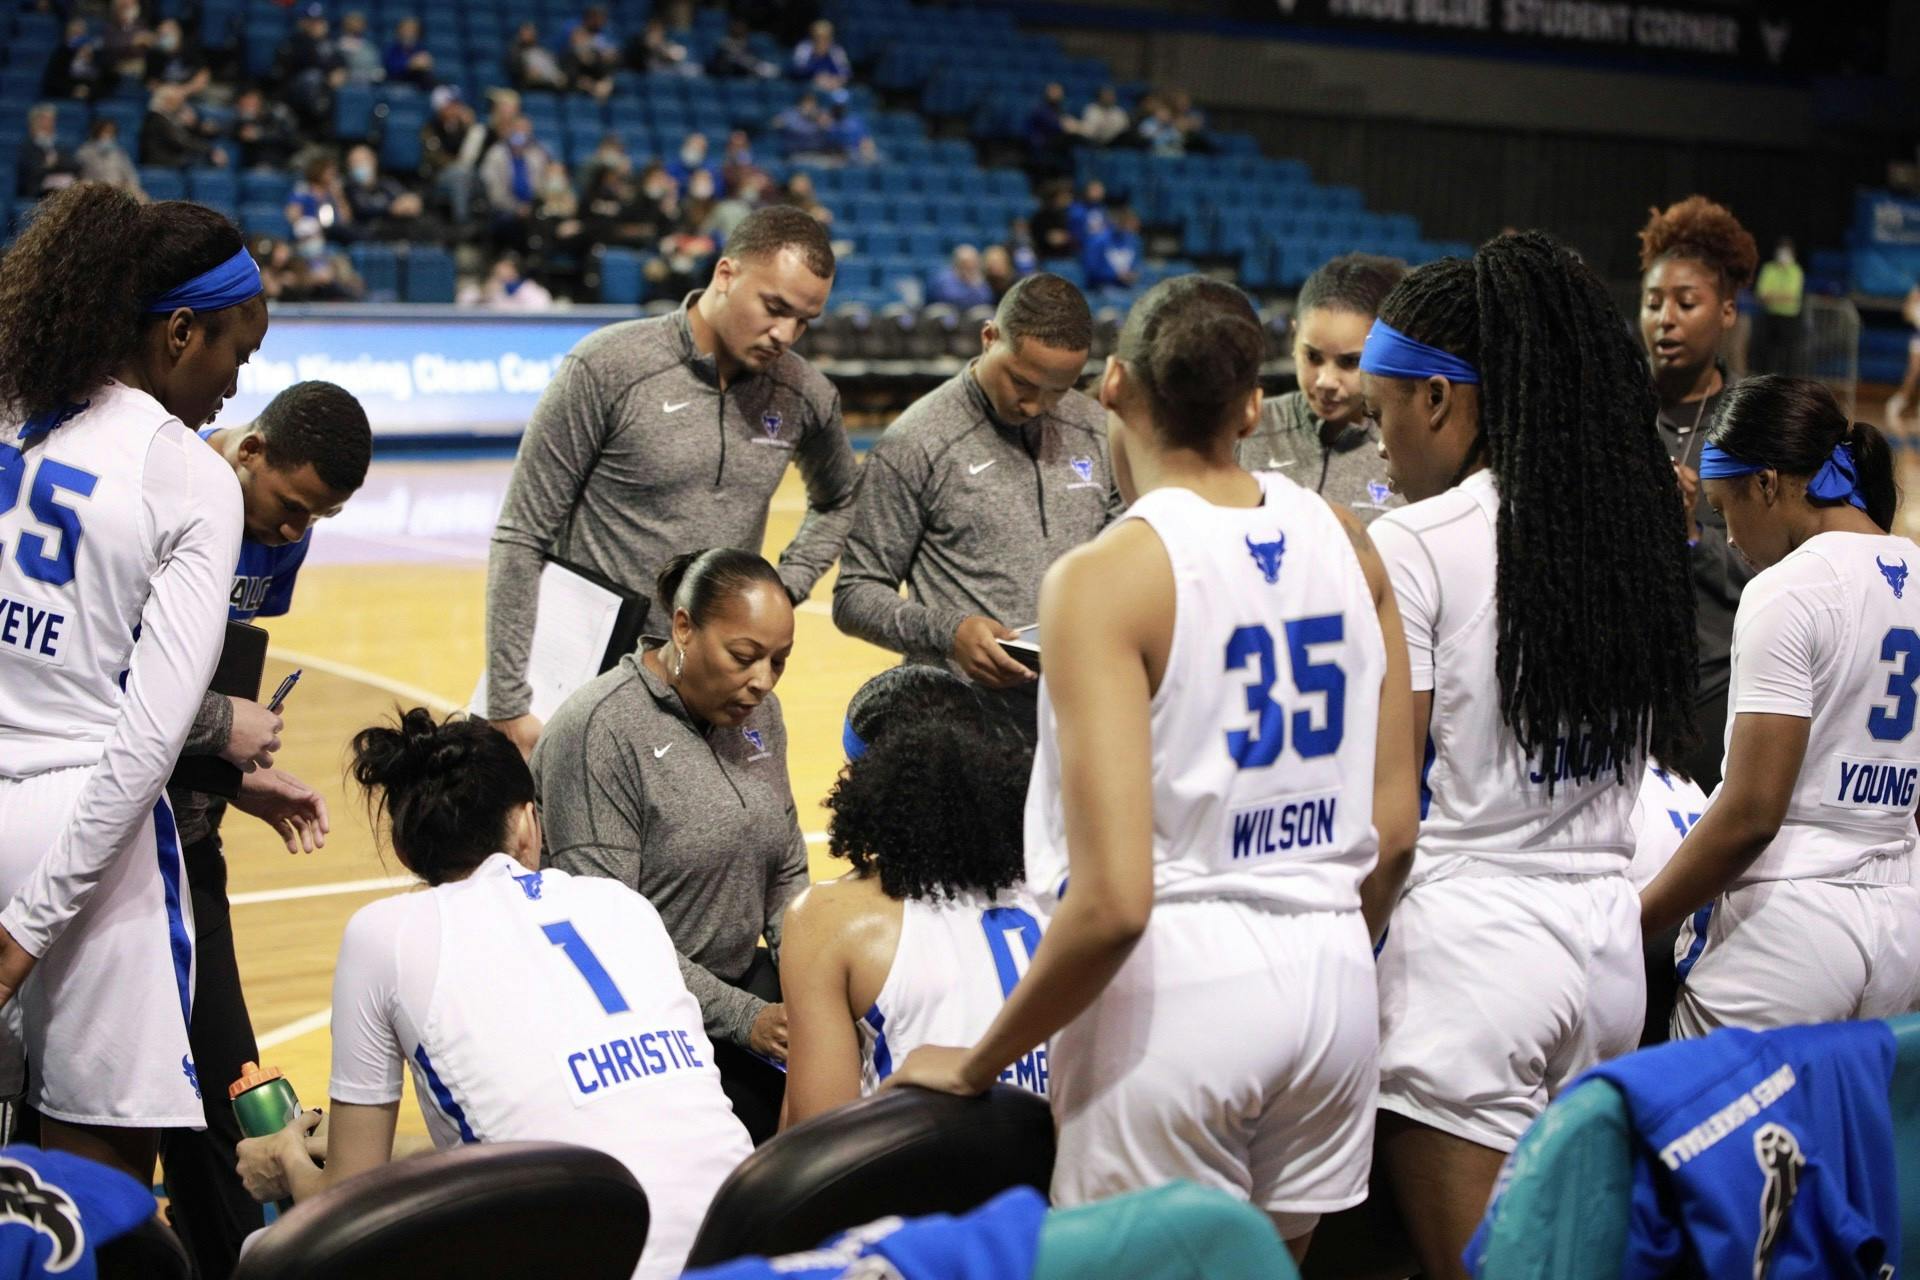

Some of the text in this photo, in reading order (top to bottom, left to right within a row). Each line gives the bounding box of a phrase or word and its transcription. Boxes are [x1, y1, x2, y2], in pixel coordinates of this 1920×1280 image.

[1223, 611, 1347, 771] 35
[1866, 625, 1920, 743] 3
[1837, 761, 1918, 807] YOUNG
[1232, 798, 1337, 860] WILSON
[540, 920, 633, 1015] 1
[567, 1029, 704, 1095] CHRISTIE
